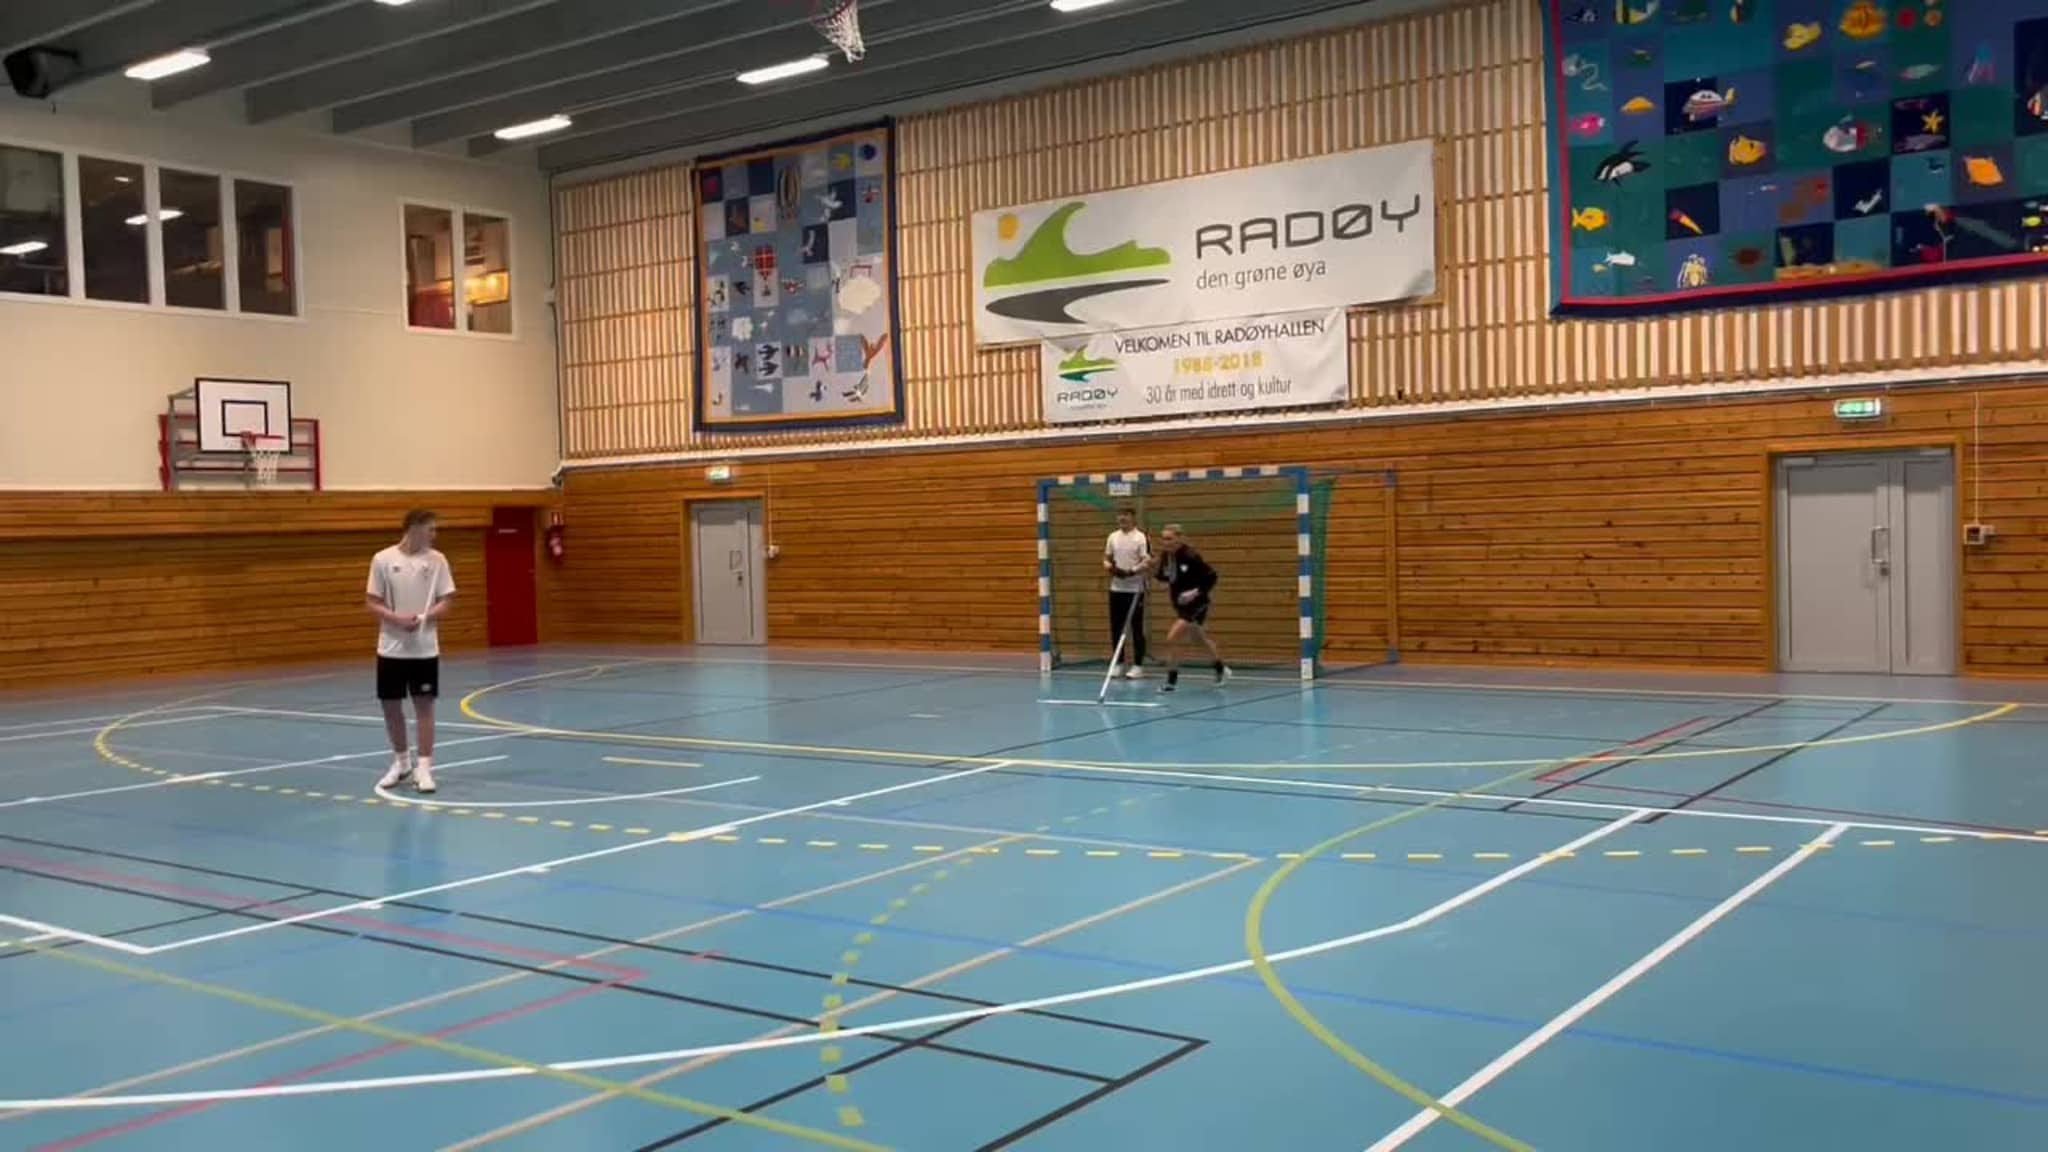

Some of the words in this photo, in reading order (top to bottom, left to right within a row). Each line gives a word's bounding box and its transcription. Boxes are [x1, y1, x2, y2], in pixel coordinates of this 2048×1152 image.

[1196, 193, 1421, 259] RADØY
[1196, 269, 1229, 290] den
[1234, 265, 1287, 290] grøne
[1292, 260, 1326, 282] øya
[1114, 332, 1191, 354] VELKOMEN
[1195, 329, 1212, 346] TIL
[1215, 319, 1325, 345] RADØYHALLEN
[1057, 386, 1119, 403] RADØY
[1145, 385, 1162, 405] 30
[1180, 380, 1205, 400] med
[1207, 380, 1237, 399] idrett
[1240, 383, 1255, 400] og
[1258, 375, 1292, 395] kultur
